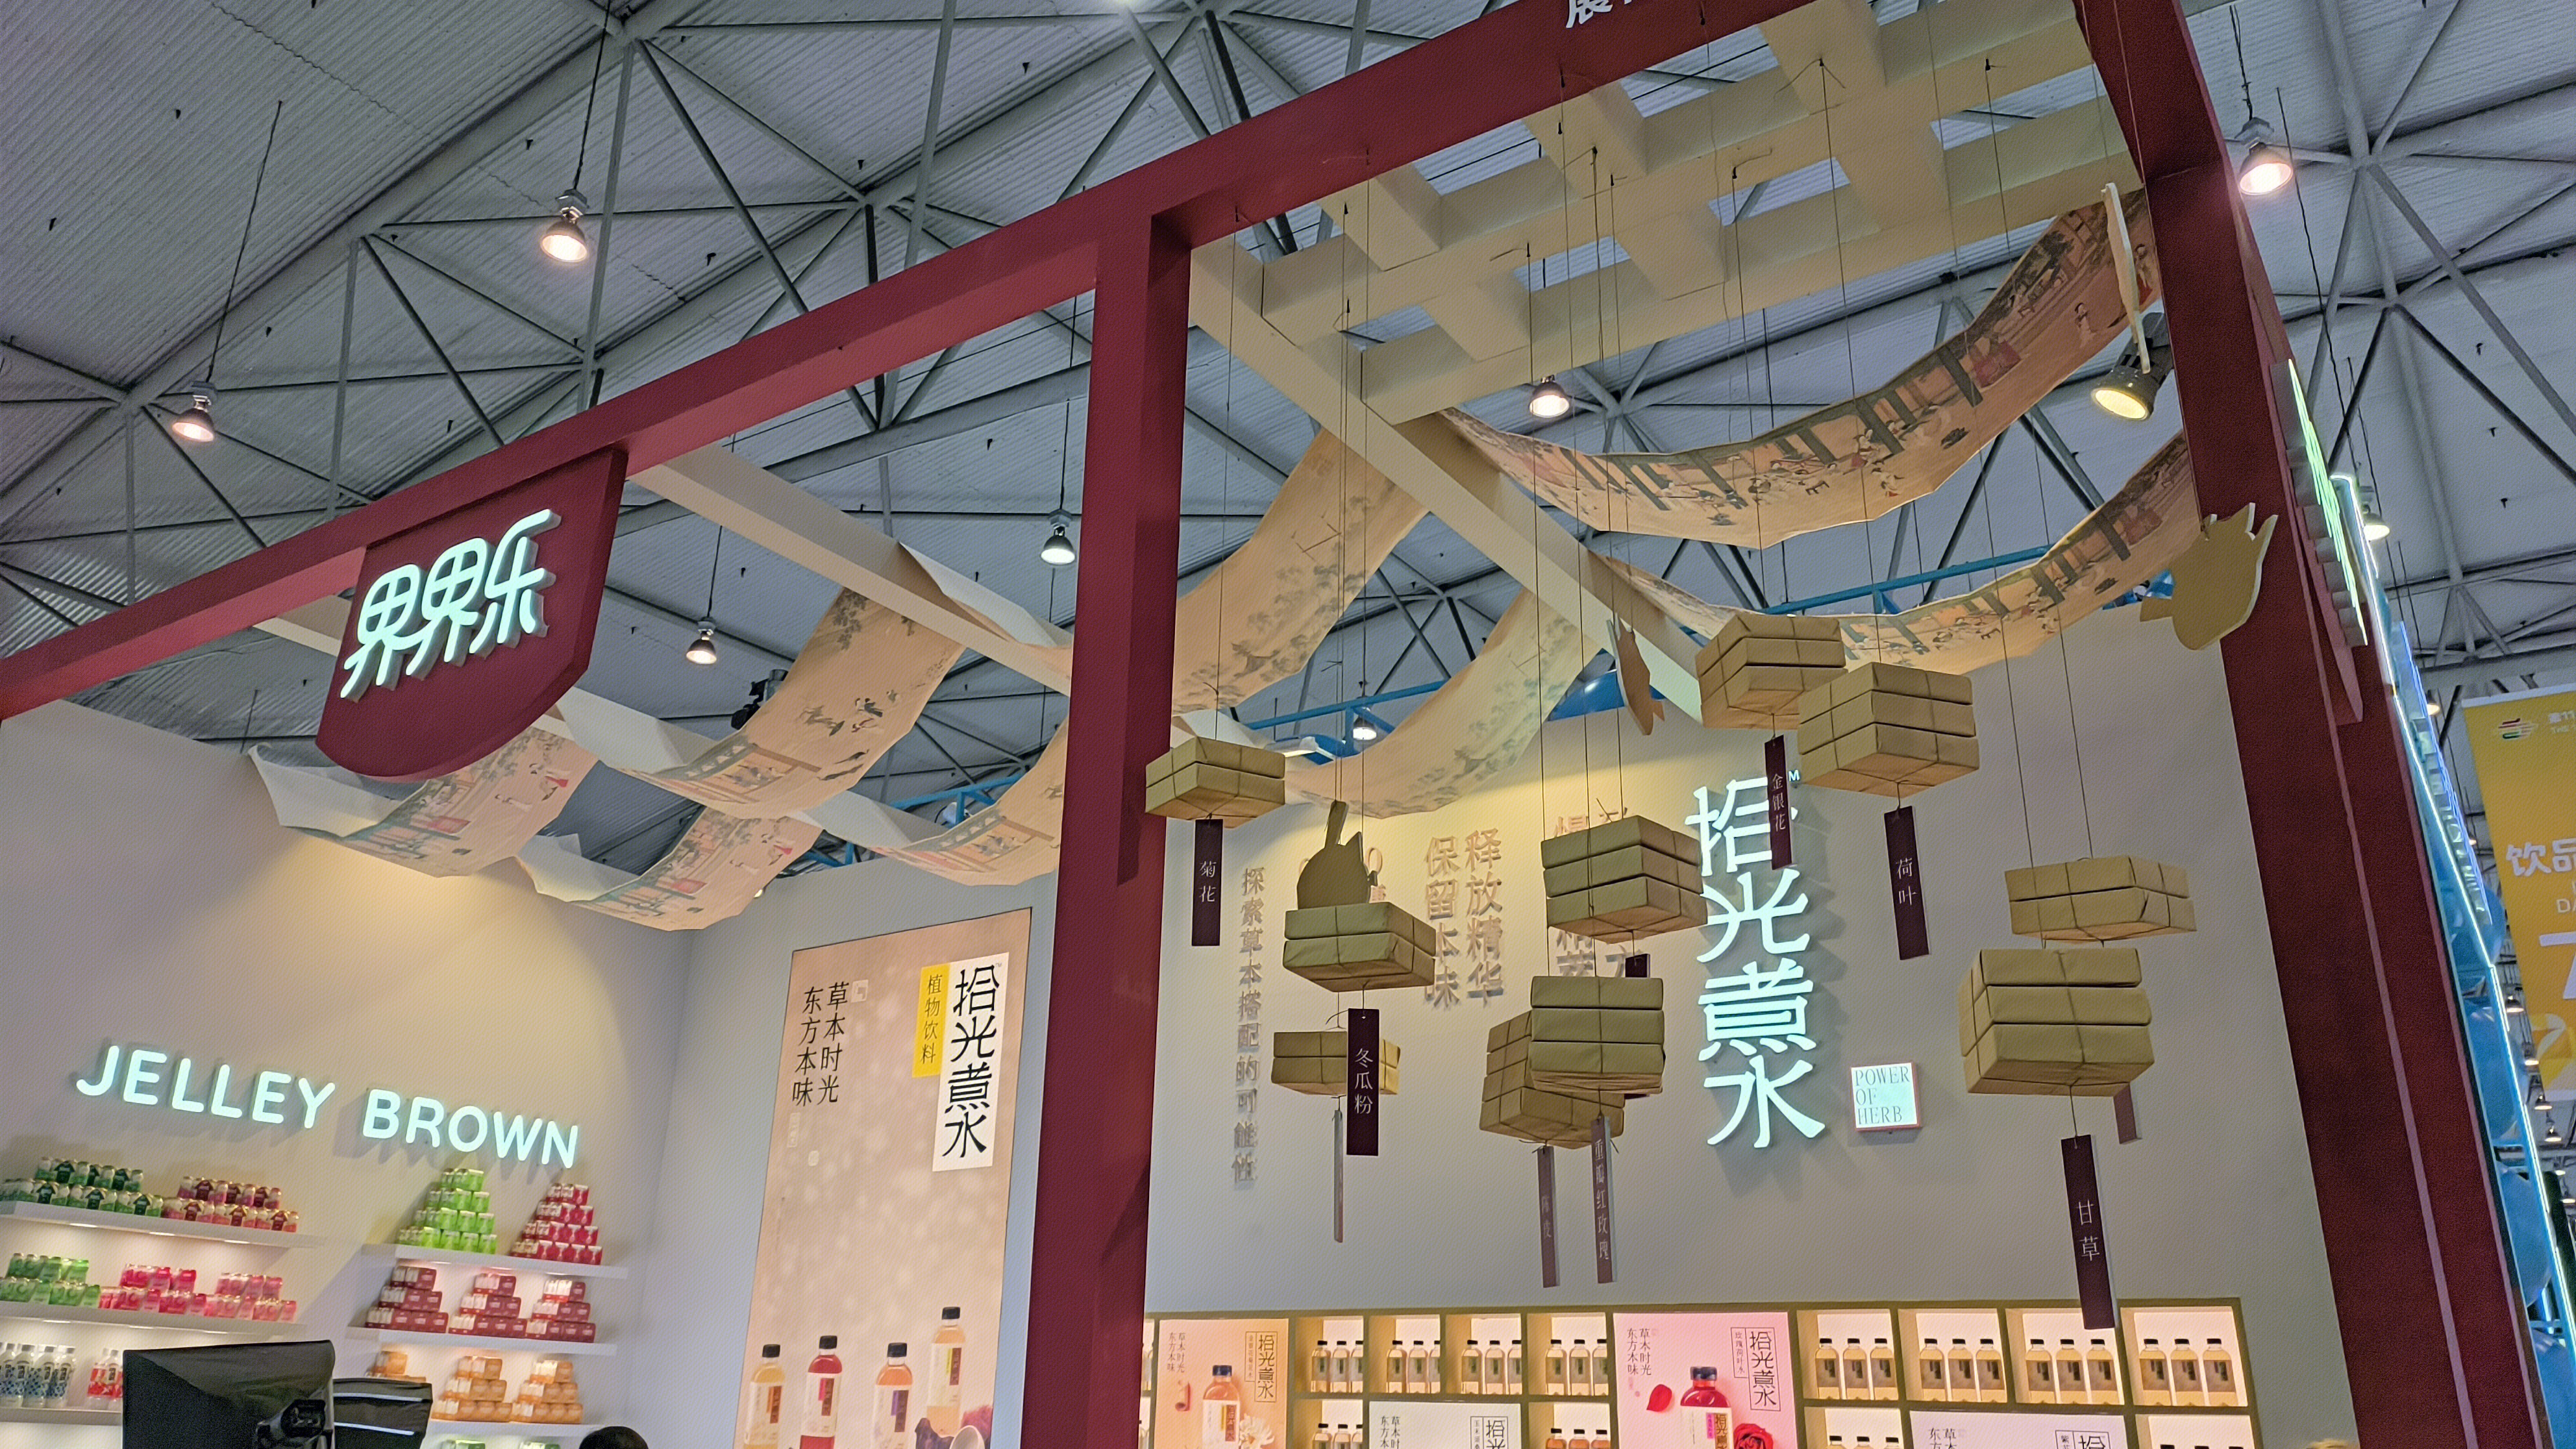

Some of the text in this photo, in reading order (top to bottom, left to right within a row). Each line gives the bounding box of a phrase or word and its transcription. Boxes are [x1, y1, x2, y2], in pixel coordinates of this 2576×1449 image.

[340, 508, 556, 700] 界界乐
[1772, 774, 1786, 831] 金银花
[1198, 861, 1217, 902] 菊花
[1895, 858, 1917, 906] 荷叶
[2557, 898, 2576, 913] D
[1424, 836, 1460, 1010] 保留本味
[1465, 828, 1503, 1007] 释放精华
[1685, 775, 1826, 1148] 拾光煮水
[792, 986, 824, 1107] 东方本味
[817, 981, 850, 1107] 草本时光
[921, 974, 943, 1065] 植物饮料
[1231, 866, 1265, 1185] 探索草本搭配的可能性
[942, 964, 1000, 1159] 拾光煮水
[1354, 1047, 1374, 1115] 冬瓜粉
[1854, 1066, 1911, 1087] POWER
[75, 1045, 579, 1169] JELLEY BROWN
[1855, 1087, 1877, 1106] OF
[1857, 1106, 1903, 1125] HERB
[2075, 1198, 2100, 1261] 甘草
[1257, 1334, 1274, 1399] 拾光煮水
[1627, 1328, 1639, 1375] 东方本味
[1639, 1328, 1652, 1376] 草本时光
[1750, 1331, 1777, 1407] 拾光煮水
